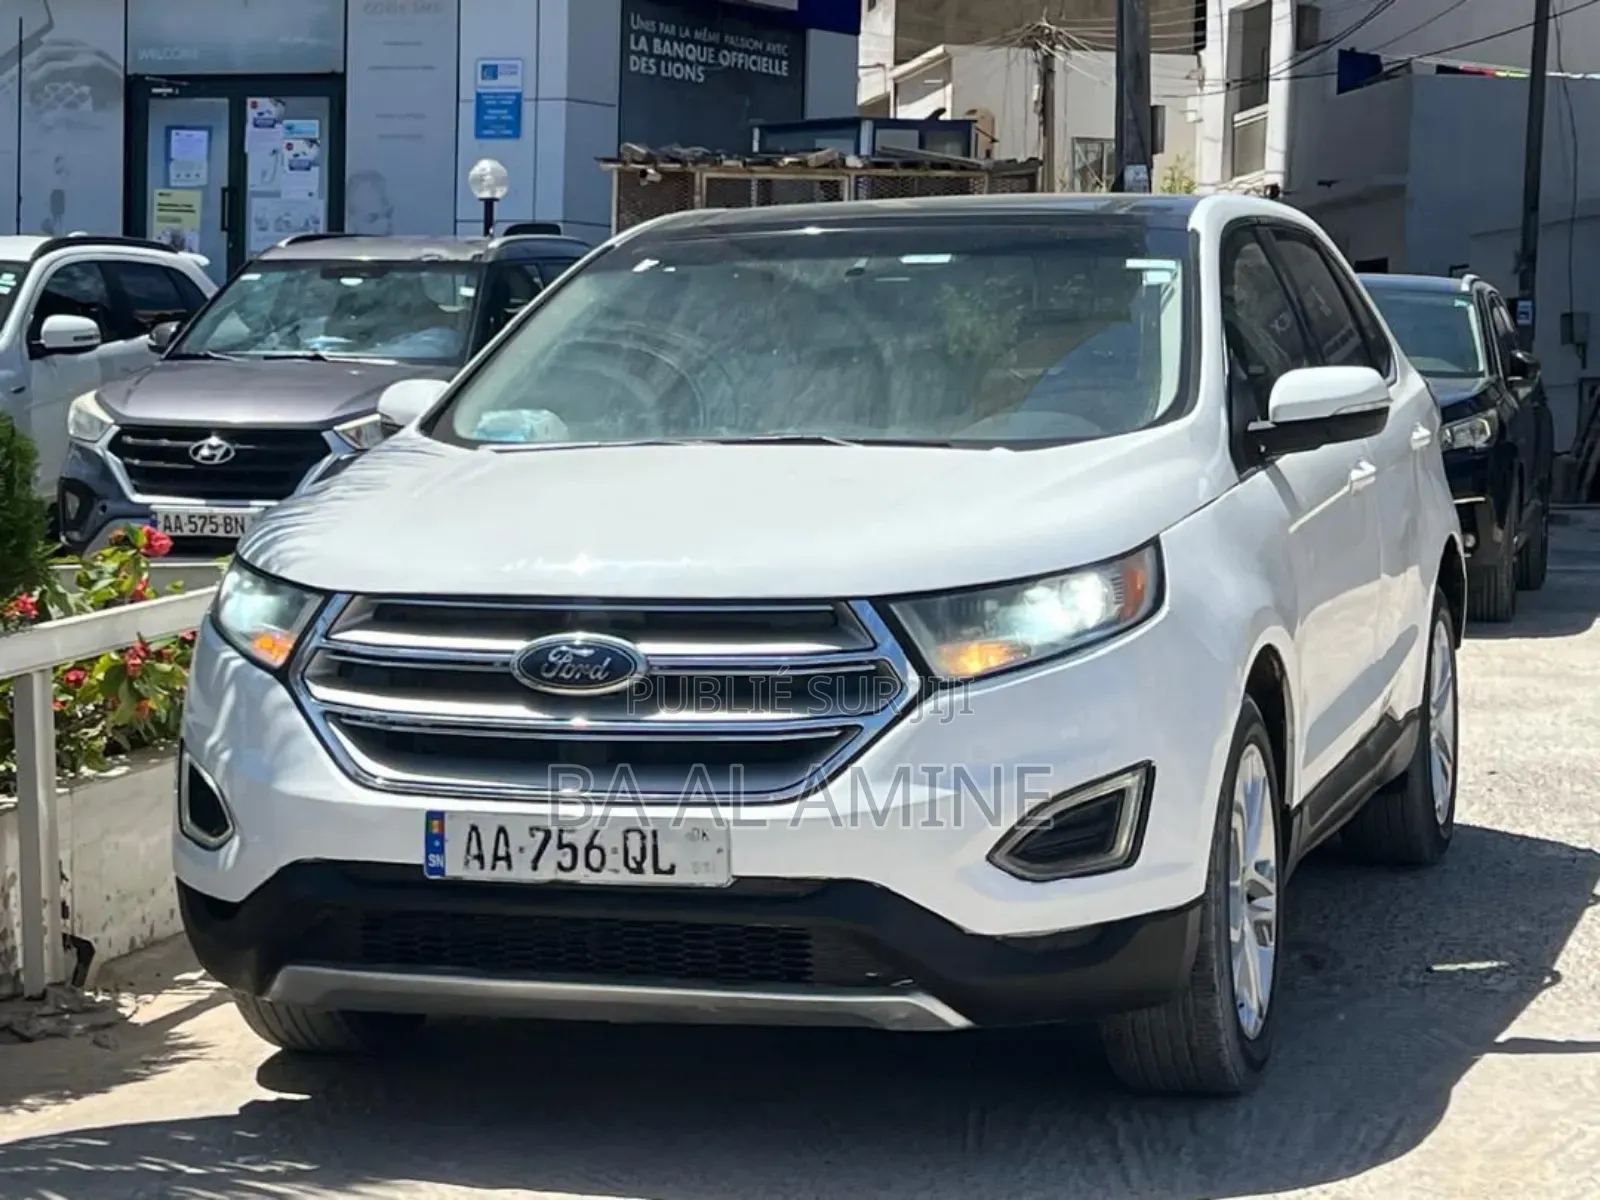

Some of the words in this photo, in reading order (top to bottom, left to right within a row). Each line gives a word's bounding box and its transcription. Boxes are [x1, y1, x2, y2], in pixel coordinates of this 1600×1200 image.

[630, 33, 649, 53] LA
[653, 38, 716, 64] BANQUE
[718, 51, 789, 77] OFFICIELLE
[659, 22, 676, 37] PAR
[679, 26, 691, 39] LA
[766, 44, 789, 57] AVEC
[629, 55, 657, 76] DES
[660, 60, 706, 83] LIONS
[540, 645, 612, 681] Ford
[427, 853, 444, 868] SN
